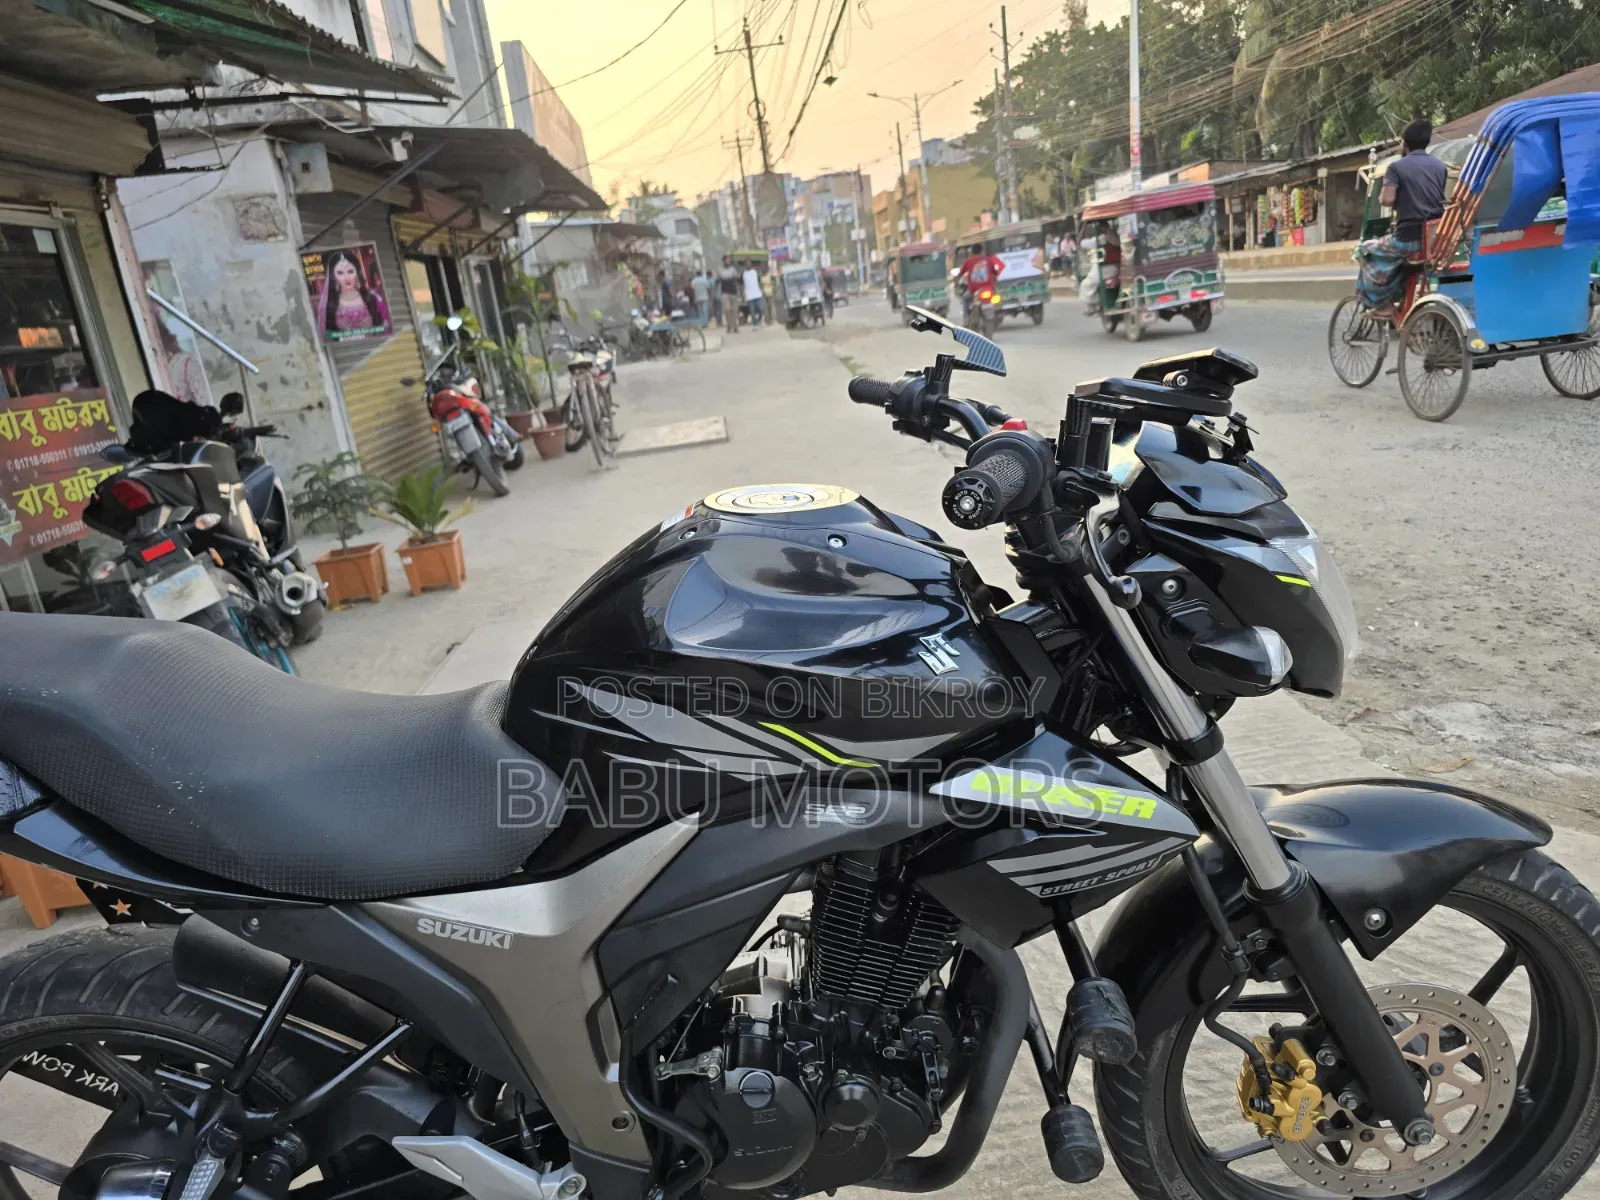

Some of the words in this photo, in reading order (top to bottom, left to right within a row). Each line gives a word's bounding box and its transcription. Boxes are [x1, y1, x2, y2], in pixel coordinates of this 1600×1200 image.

[12, 482, 69, 519] বাবু
[1041, 876, 1102, 895] STREET
[1105, 857, 1158, 881] SPORT
[416, 917, 511, 950] SUZUKI
